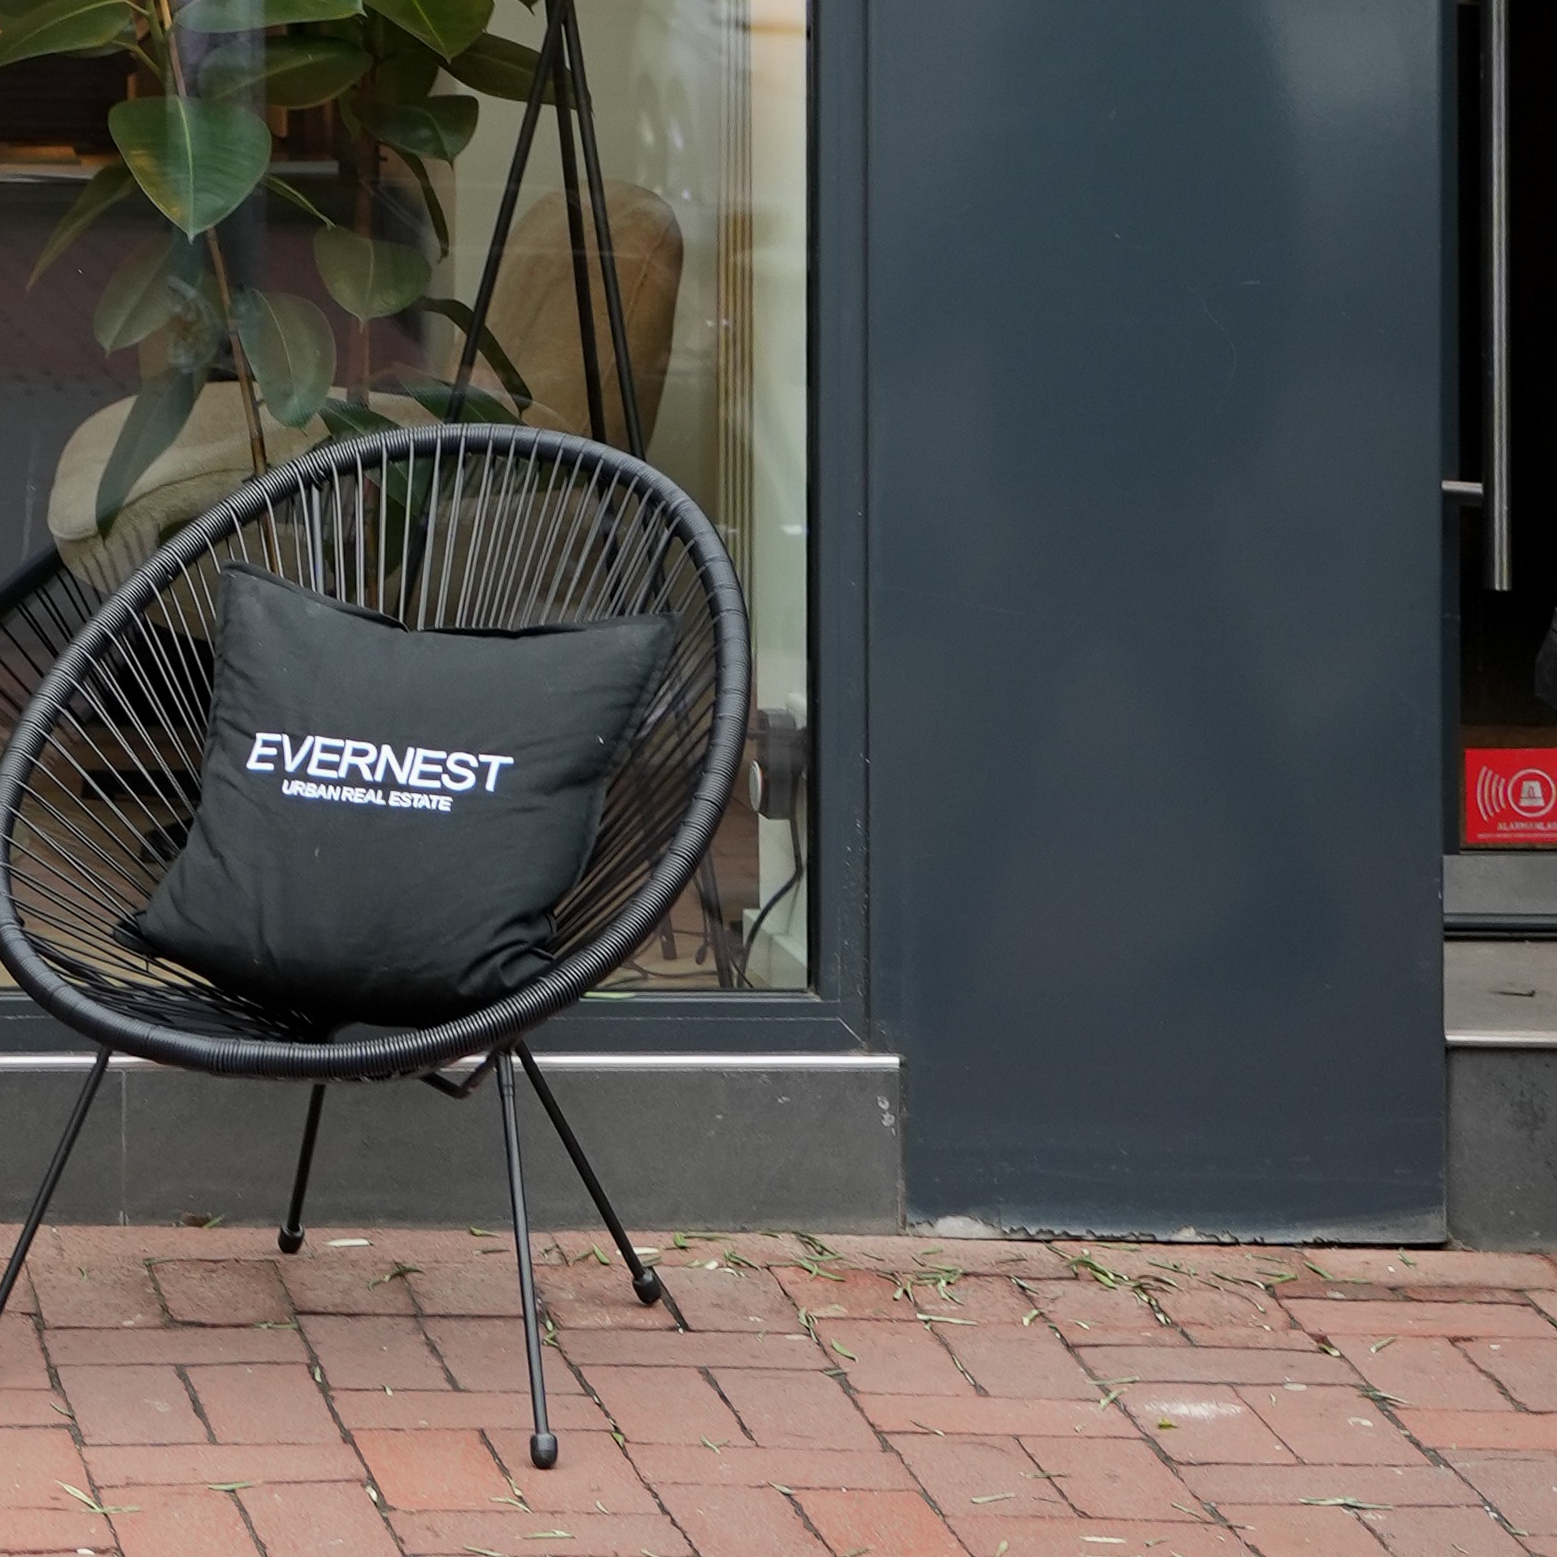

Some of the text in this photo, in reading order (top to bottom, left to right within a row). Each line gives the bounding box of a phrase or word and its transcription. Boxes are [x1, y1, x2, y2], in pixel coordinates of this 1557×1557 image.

[245, 732, 515, 793] EVERNEST
[281, 779, 454, 812] URBAN REAL ESTATE
